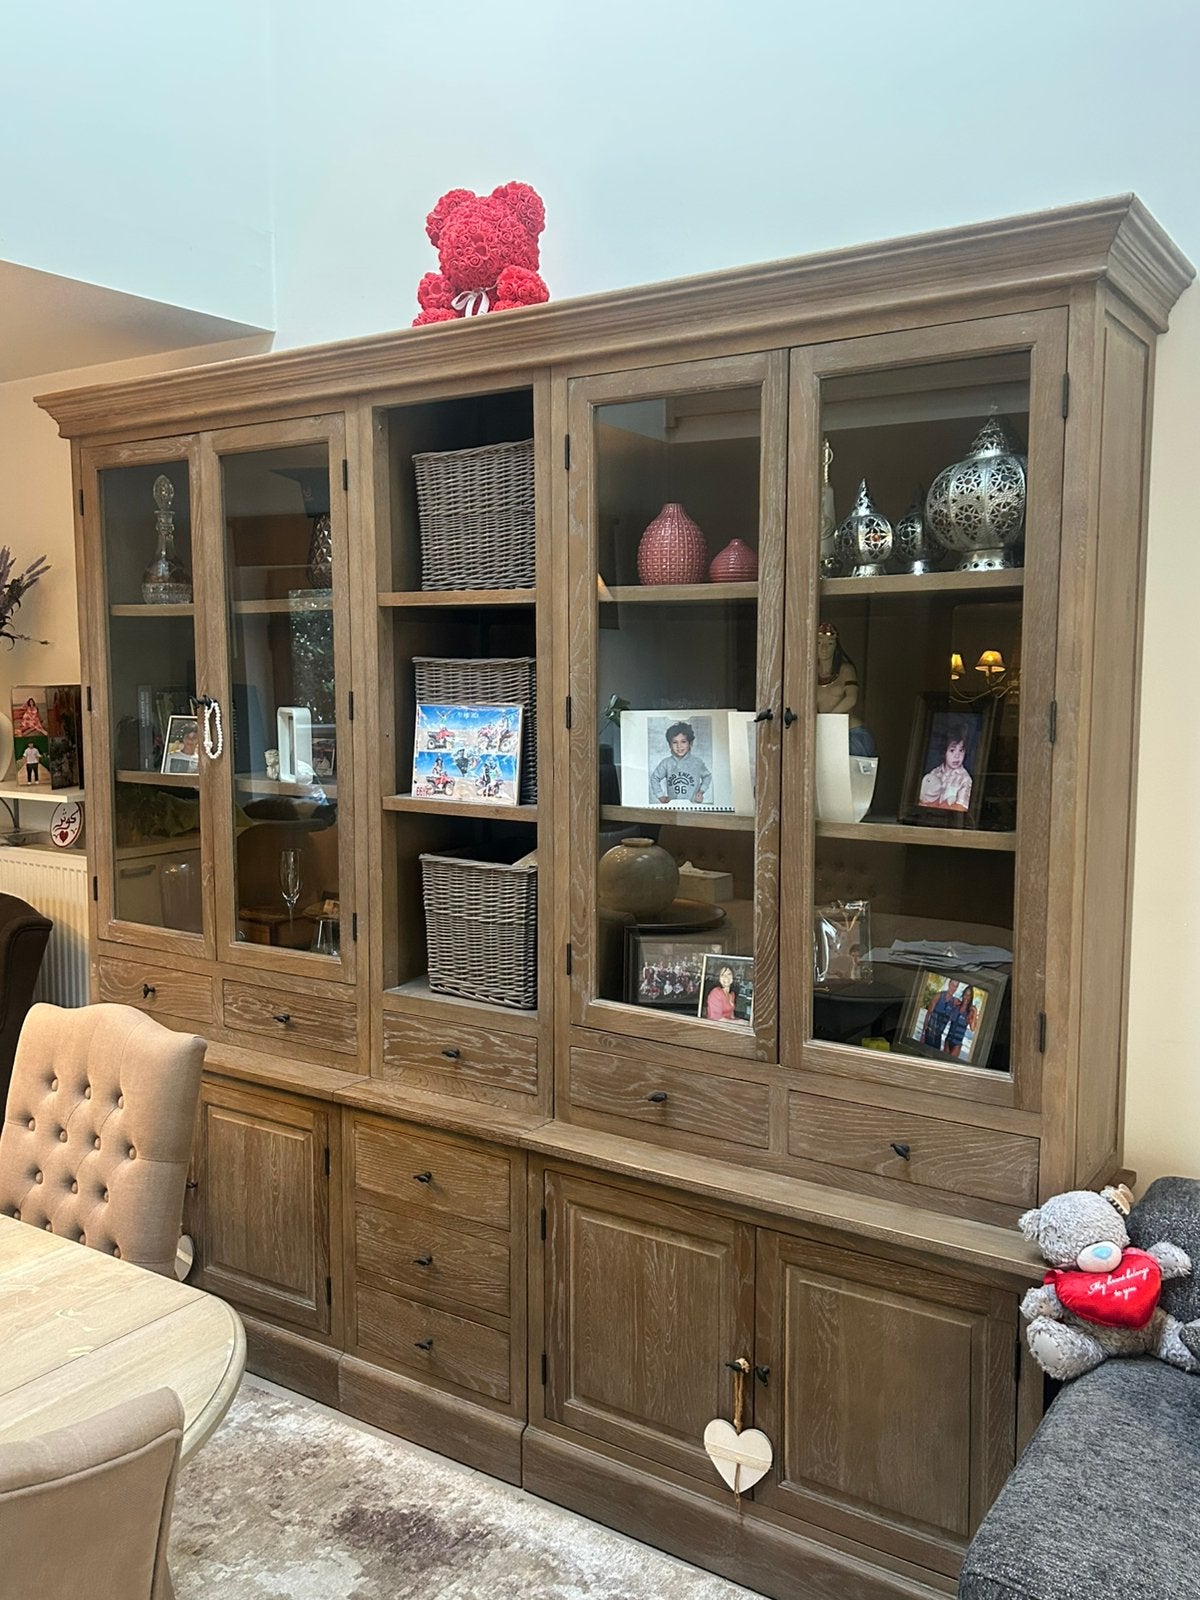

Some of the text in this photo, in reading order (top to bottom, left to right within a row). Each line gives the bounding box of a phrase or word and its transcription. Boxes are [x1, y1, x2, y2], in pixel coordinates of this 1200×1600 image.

[674, 785, 687, 794] 96
[53, 807, 79, 832] كوثر
[1088, 1267, 1149, 1295] My heart belongs
[1114, 1287, 1137, 1301] to you
